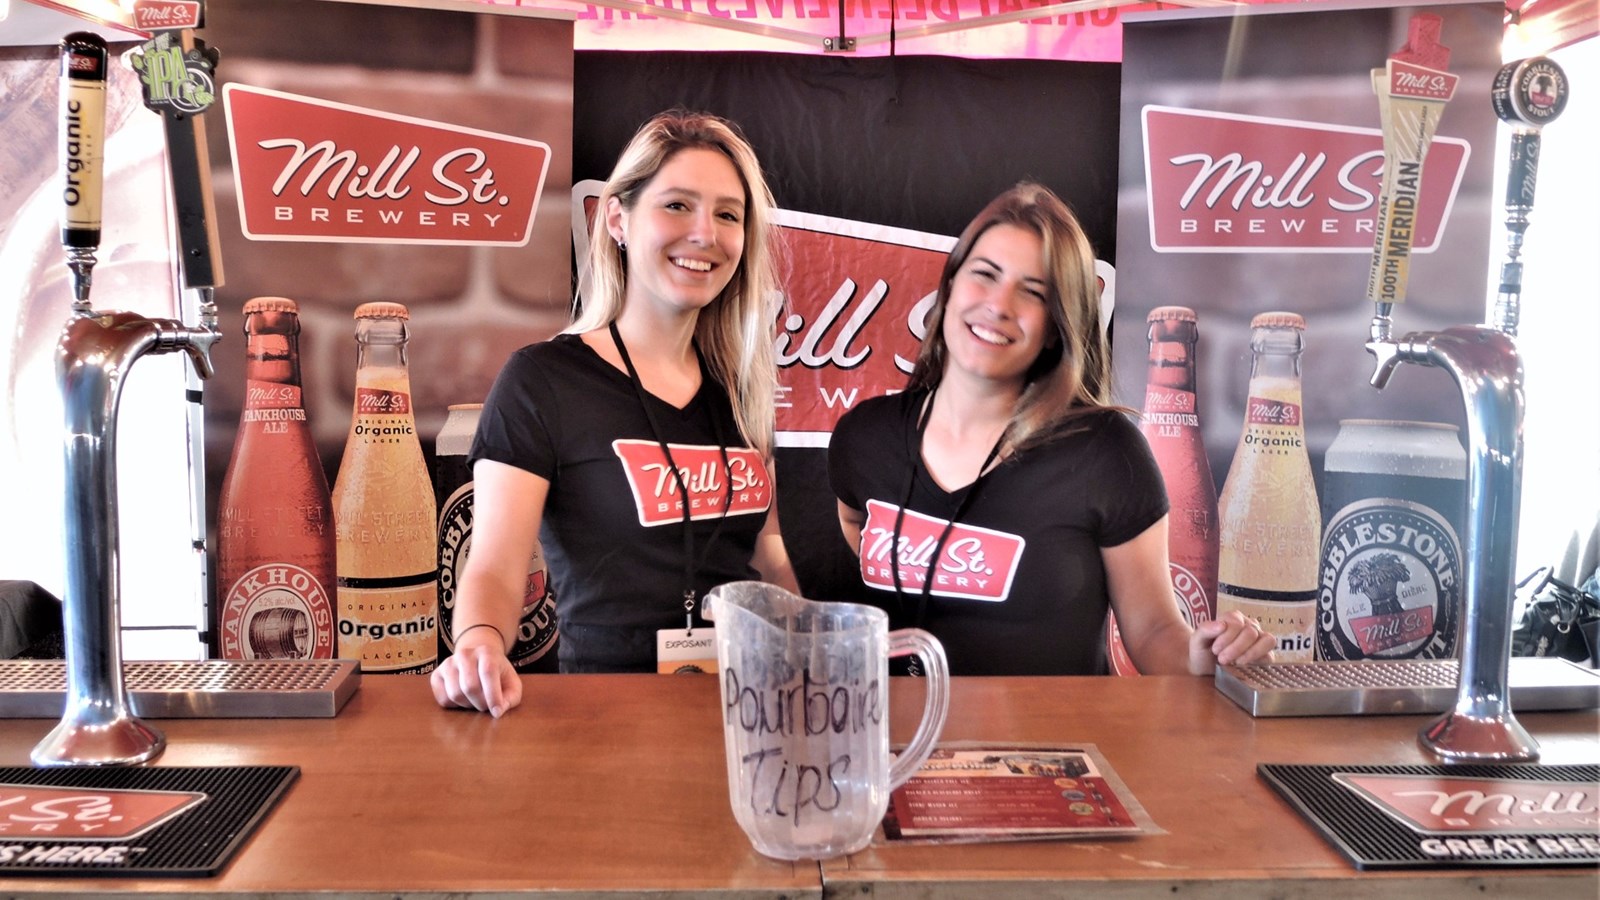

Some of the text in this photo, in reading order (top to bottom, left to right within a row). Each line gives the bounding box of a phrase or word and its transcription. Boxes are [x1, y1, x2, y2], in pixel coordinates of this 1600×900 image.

[138, 5, 192, 20] Mill St.
[144, 46, 188, 100] IPA
[1395, 72, 1448, 91] Mill St.
[1527, 104, 1554, 117] STOUT
[63, 100, 84, 206] Organic
[258, 138, 509, 206] Mill St.
[1169, 151, 1326, 211] Mill
[1522, 159, 1537, 199] Mill
[275, 206, 503, 228] BREWERY
[1180, 219, 1374, 234] BREWER
[1382, 161, 1420, 299] 100TH MERIDIAN
[1368, 195, 1388, 298] 100TH MERIDIAN
[769, 277, 889, 368] ill
[249, 387, 297, 401] Mill St.
[360, 394, 406, 408] Mill St.
[1148, 392, 1174, 404] Mill
[244, 408, 307, 422] TANKHOUSE
[1251, 403, 1280, 417] Mill
[262, 421, 289, 434] ALE
[355, 425, 412, 436] Organic
[1158, 425, 1182, 438] ALE
[1244, 434, 1302, 447] Organic
[641, 457, 764, 497] Mill St.
[867, 527, 994, 576] Mill St.
[867, 565, 989, 589] BREWERY
[1321, 522, 1455, 632] COBBLESTONE
[225, 568, 330, 656] TANKHOUSE
[347, 600, 426, 611] ORIGINAL
[518, 592, 558, 642] OUT
[1346, 603, 1366, 616] ALE
[338, 614, 435, 639] Organic
[1248, 615, 1303, 624] GINAL
[1360, 618, 1400, 643] Mill
[363, 650, 414, 660] LAGER
[665, 639, 713, 649] EXPOSANT
[726, 666, 880, 737] Pourboire
[742, 747, 851, 828] Tips
[9, 795, 124, 822] St.
[1392, 790, 1599, 816] Mill
[1420, 838, 1600, 856] GREAT BEE
